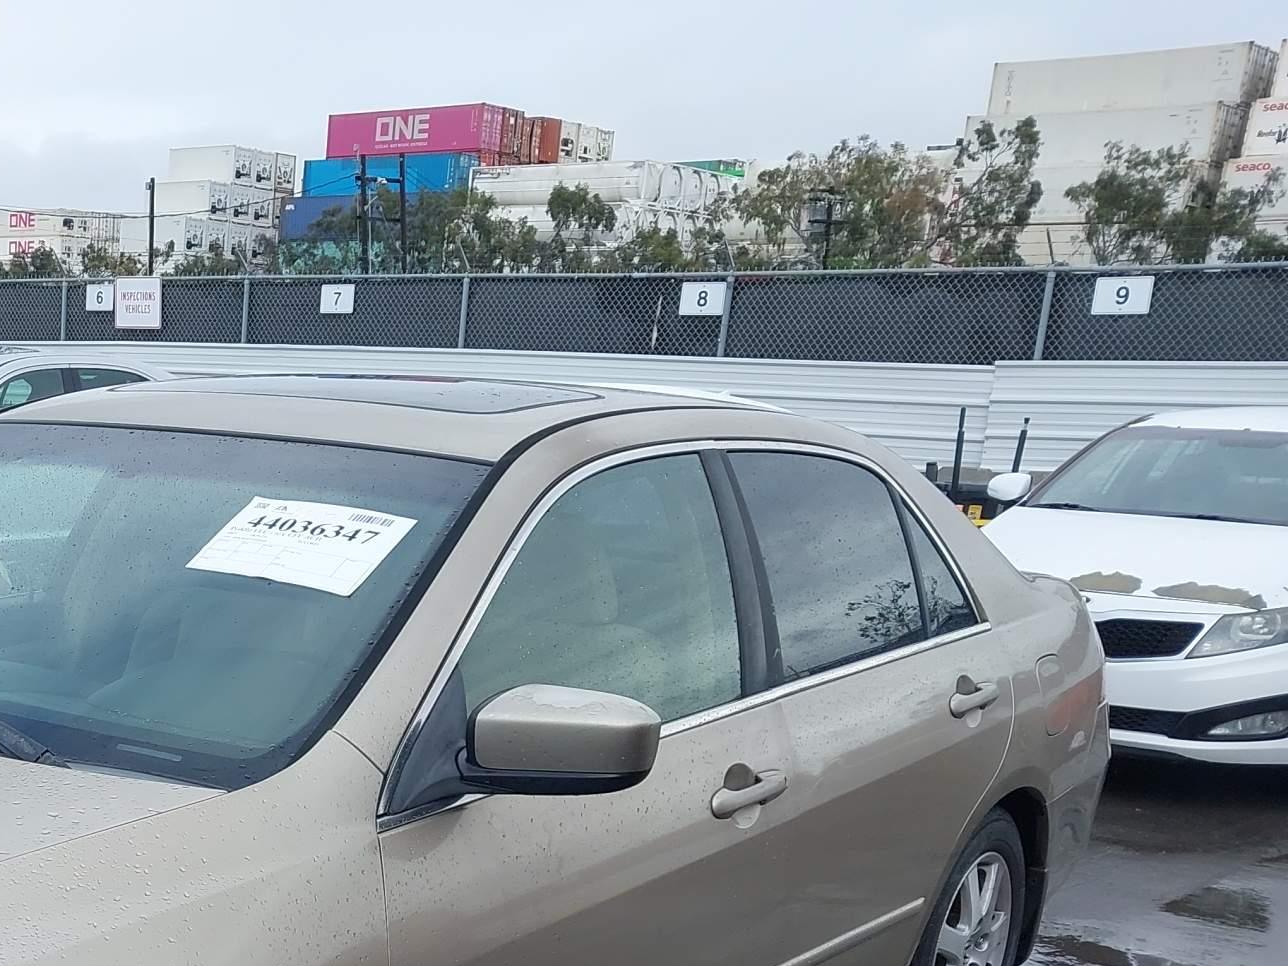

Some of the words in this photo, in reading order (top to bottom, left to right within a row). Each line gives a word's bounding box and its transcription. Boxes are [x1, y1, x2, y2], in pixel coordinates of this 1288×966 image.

[375, 114, 431, 142] ONE
[1235, 162, 1271, 172] seaco
[9, 213, 35, 228] ONE
[9, 240, 35, 255] ONE
[96, 290, 104, 304] 6
[120, 291, 156, 301] INSPECTIONS
[333, 292, 342, 306] 7
[697, 290, 709, 307] 8
[1115, 286, 1130, 305] 9
[124, 304, 151, 314] VEHICLES
[248, 515, 381, 545] 44036347
